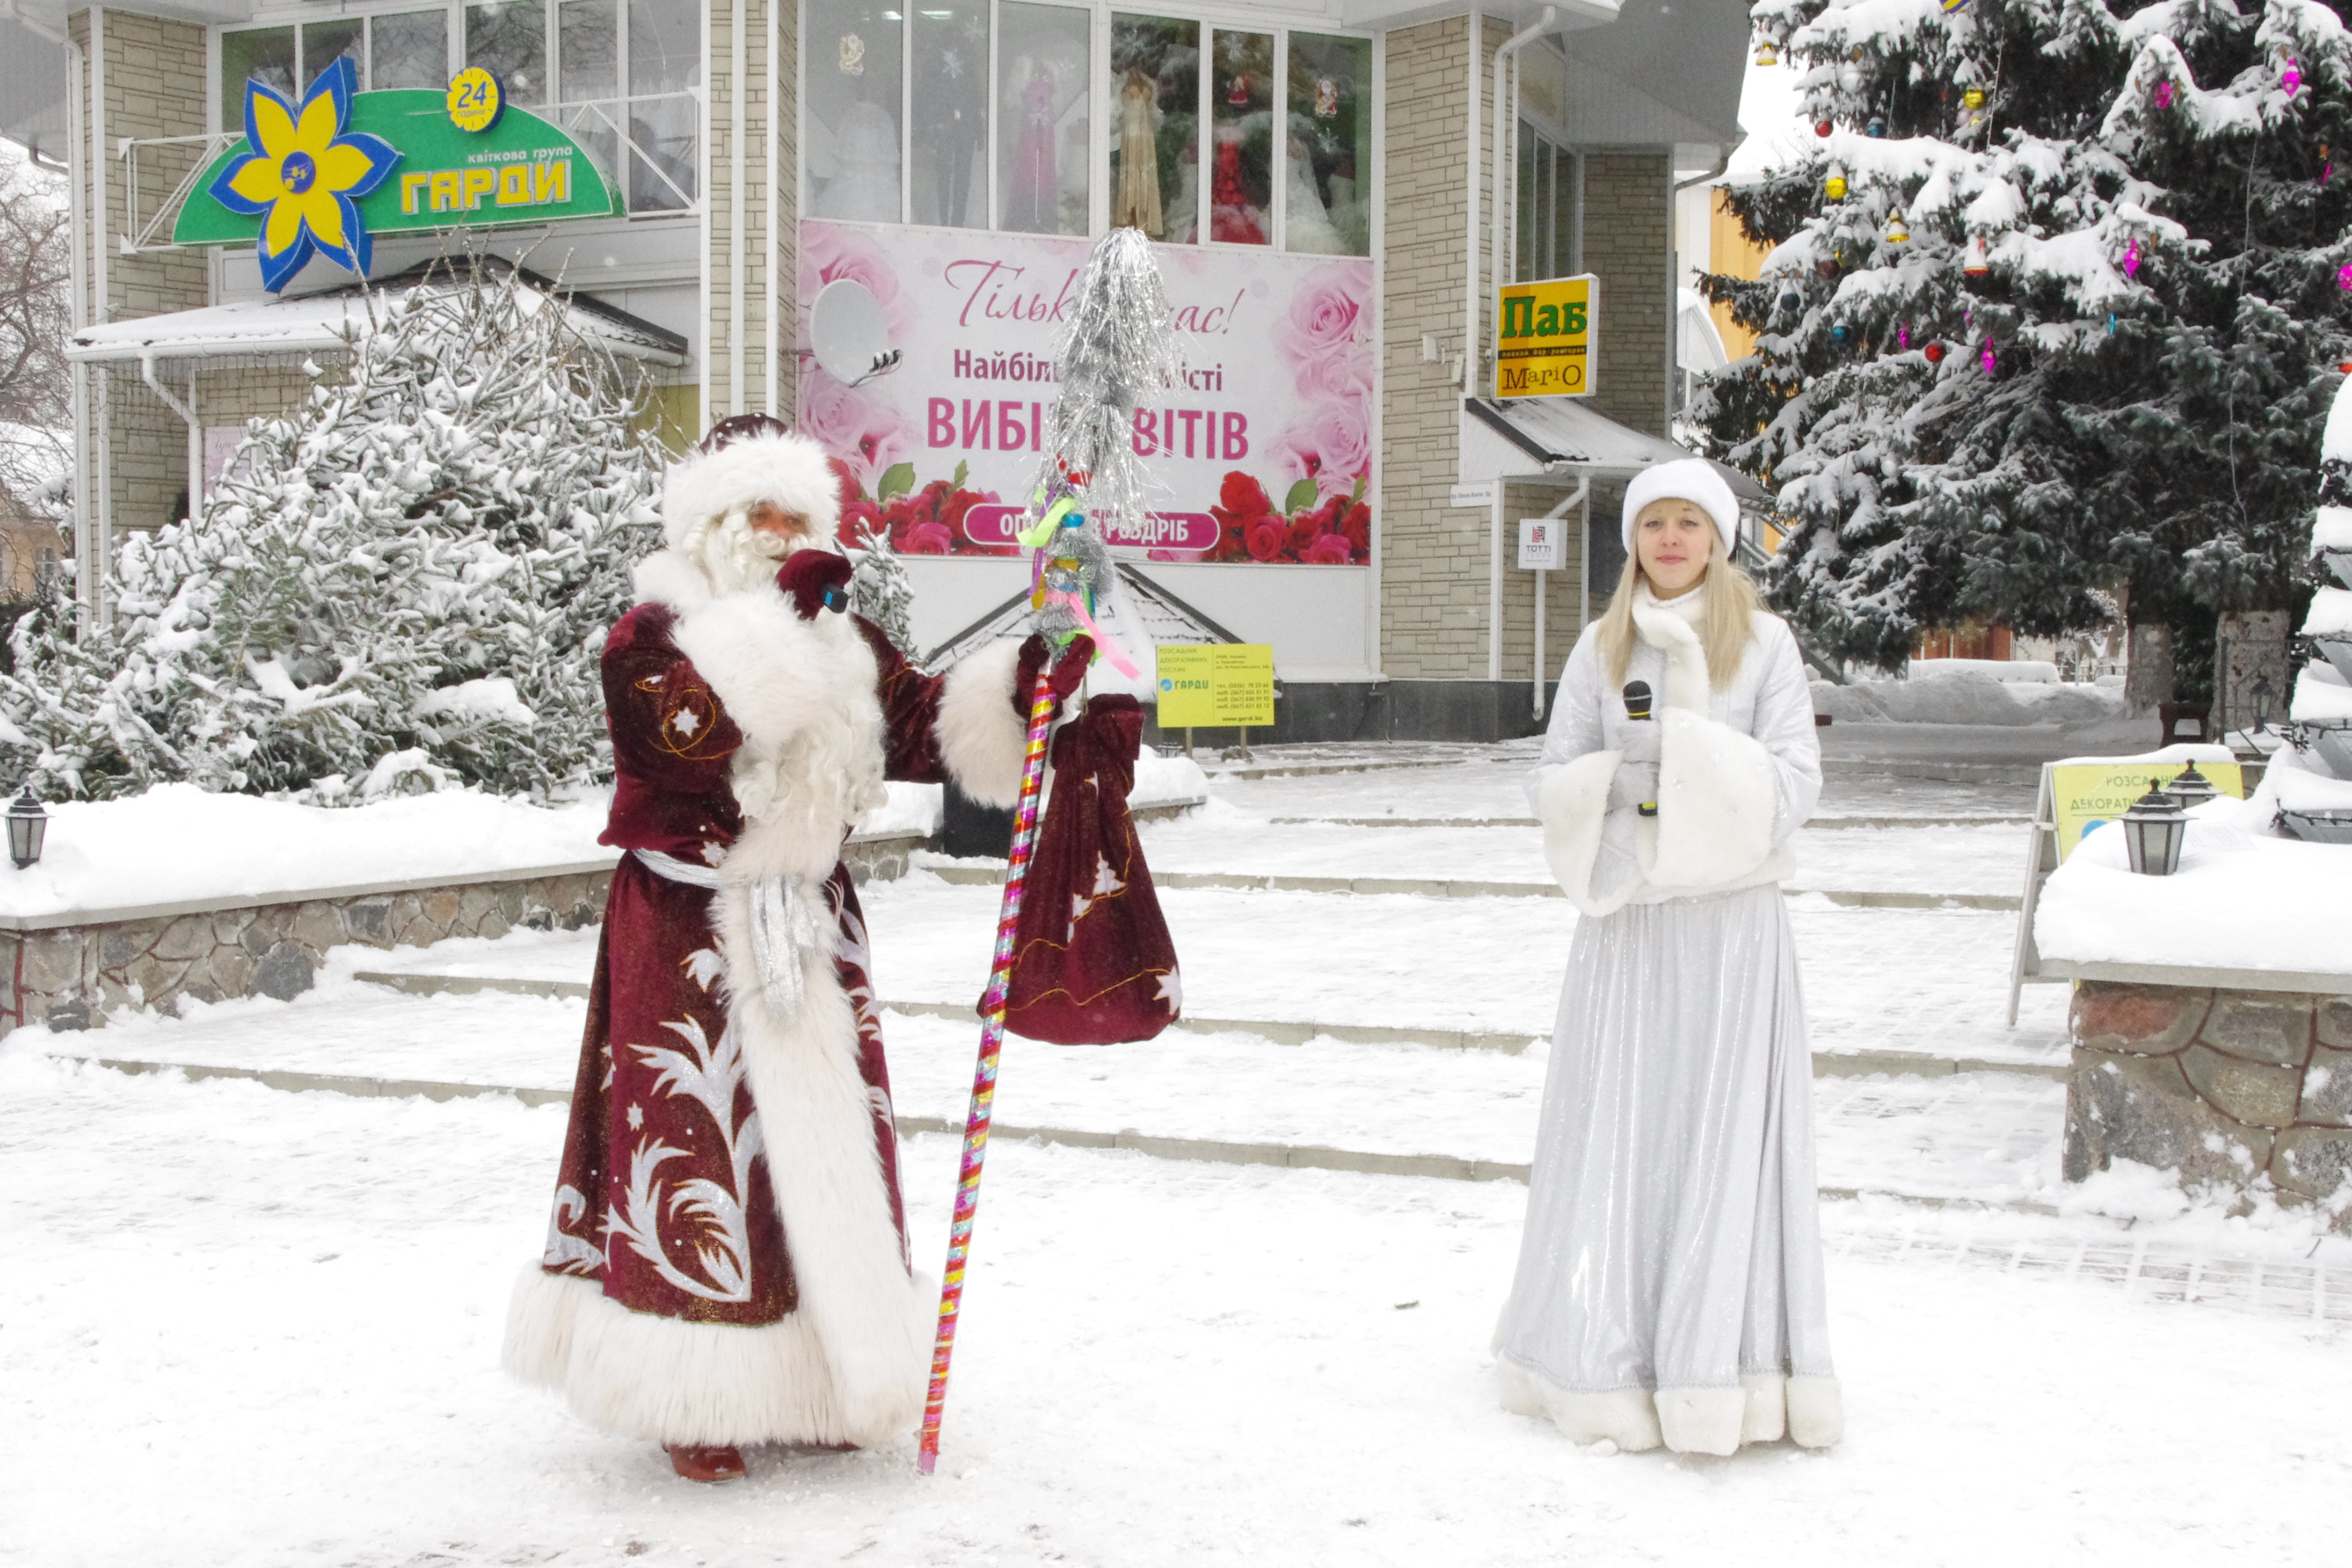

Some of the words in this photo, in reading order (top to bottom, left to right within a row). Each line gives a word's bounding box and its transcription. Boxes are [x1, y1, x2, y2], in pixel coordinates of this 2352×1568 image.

[458, 81, 487, 108] 24
[467, 149, 527, 163] квіткова
[532, 146, 573, 162] група
[401, 160, 571, 215] ГАРДИ
[945, 259, 1078, 327] Тільк
[1169, 288, 1245, 335] ас!
[954, 348, 1061, 383] Найбіл
[927, 397, 1055, 452] ВИБІ
[1132, 407, 1249, 461] ВІТІВ
[2106, 775, 2178, 787] РОЗСАНИ
[2070, 798, 2137, 810] ДЕКОРАТИ
